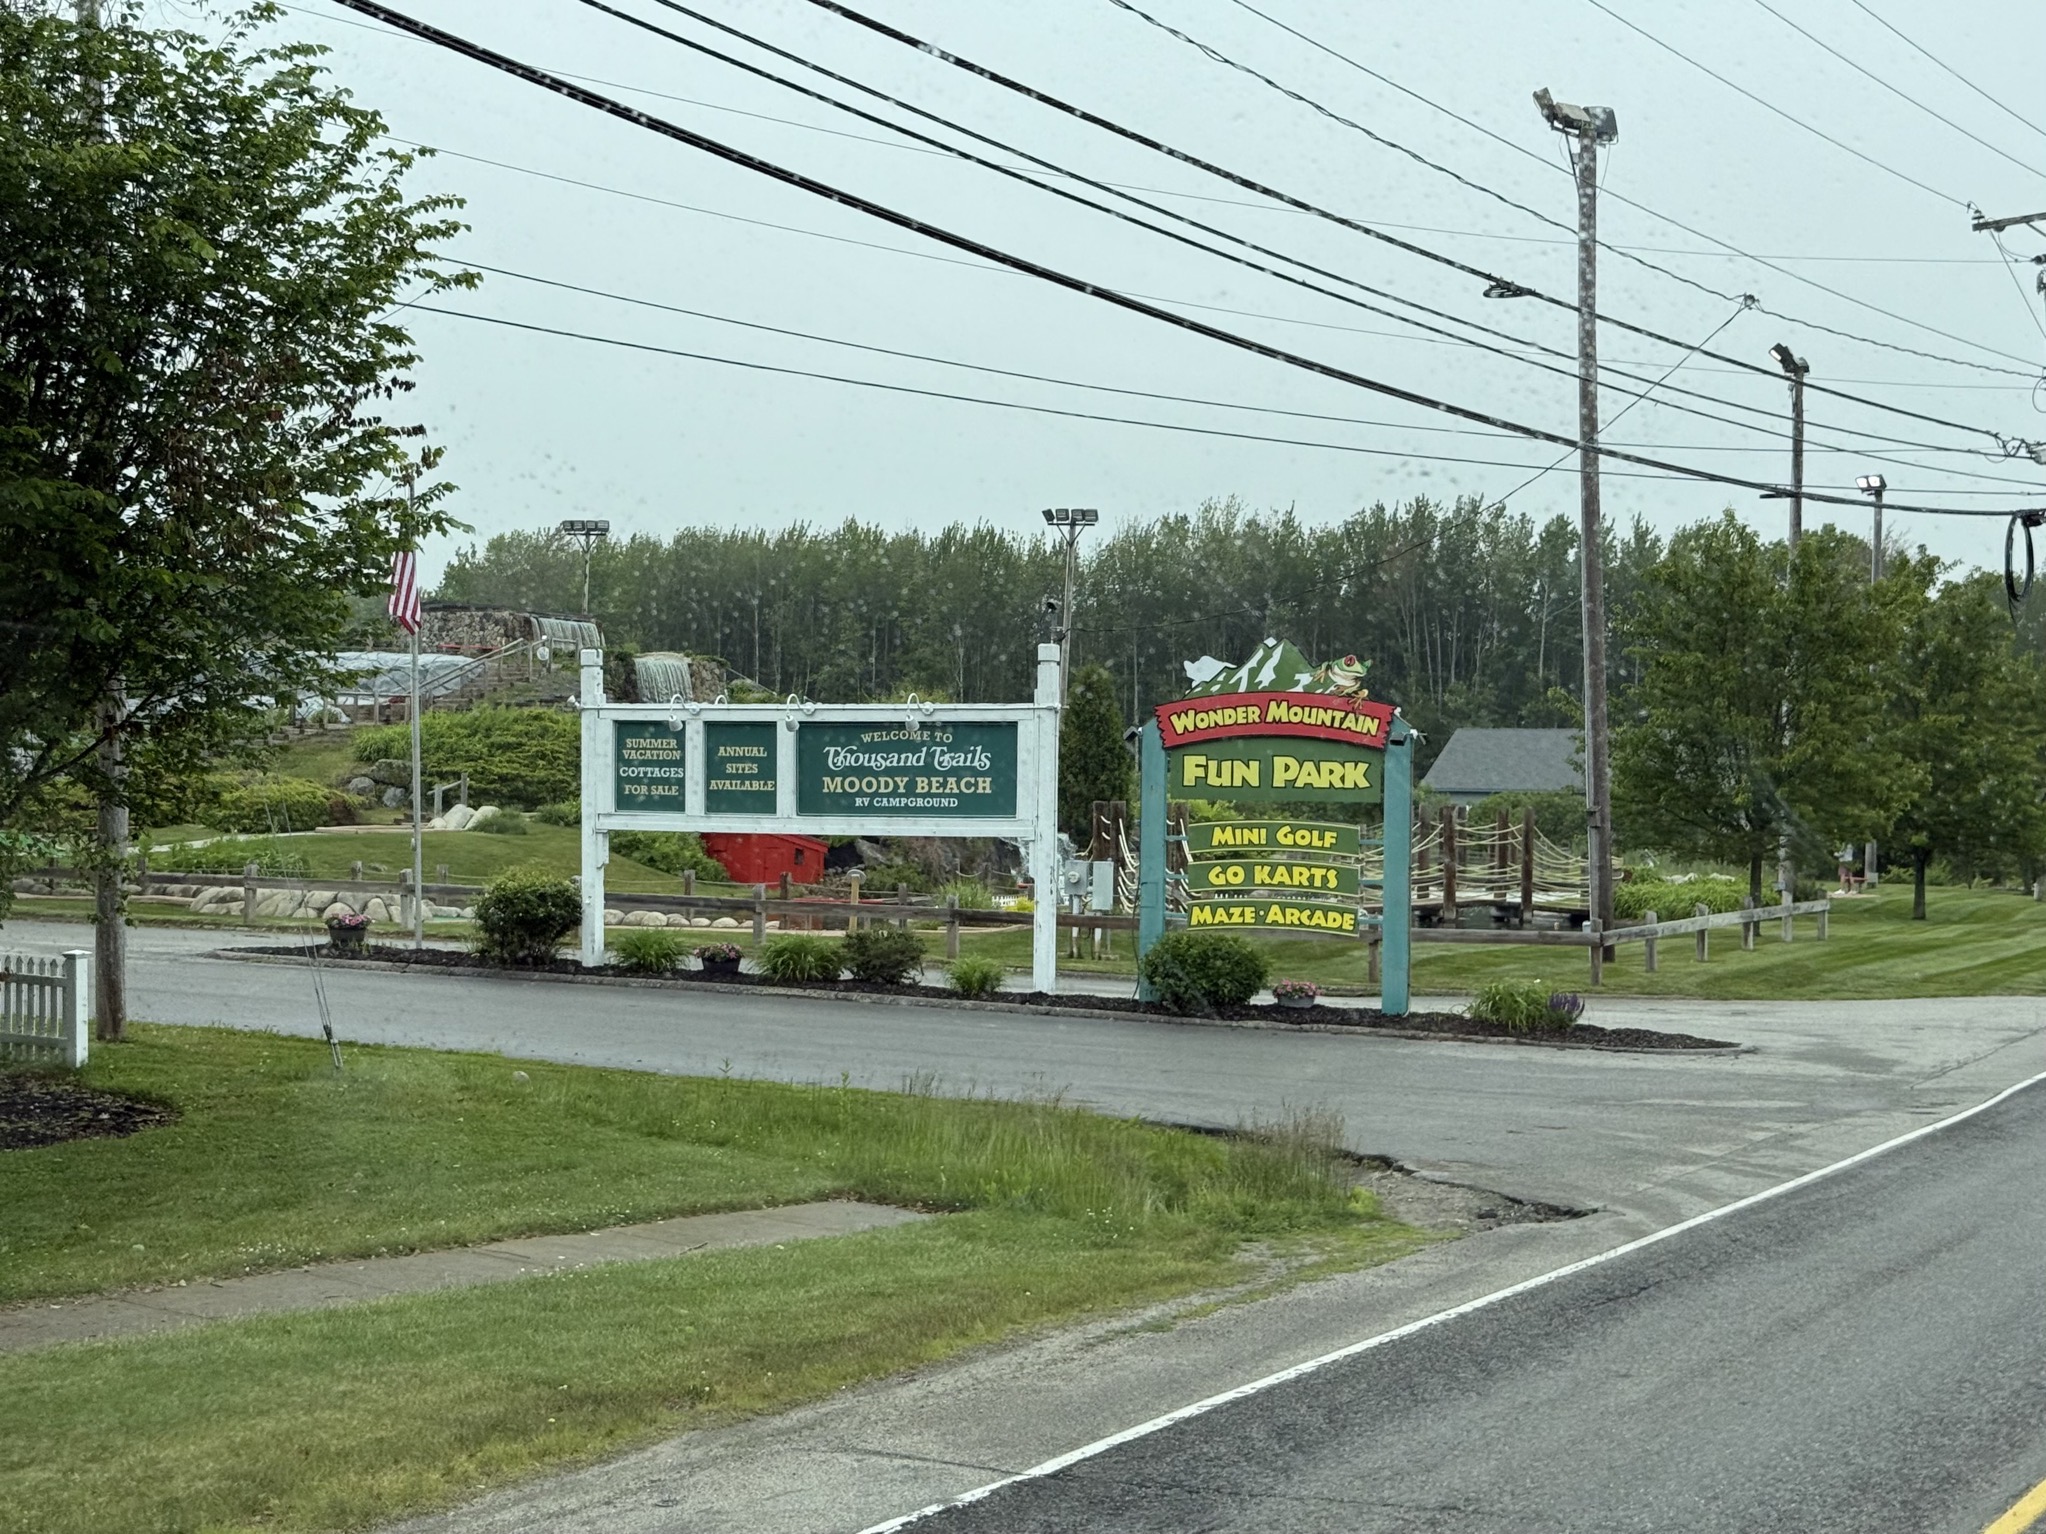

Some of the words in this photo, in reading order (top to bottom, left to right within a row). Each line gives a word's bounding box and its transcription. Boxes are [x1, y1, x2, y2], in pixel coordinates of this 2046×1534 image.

[1169, 705, 1261, 735] WONDER
[1265, 700, 1380, 736] MOUNTAIN
[626, 738, 678, 749] SUMMER
[861, 730, 931, 744] WELCOME
[934, 731, 953, 743] TO
[622, 750, 681, 760] VACATION
[717, 746, 767, 757] ANNUAL
[823, 745, 926, 771] Thousand
[929, 745, 991, 771] Trails
[619, 767, 684, 778] COTTAGES
[725, 763, 758, 774] SITES
[1183, 755, 1260, 787] FUN
[1272, 755, 1371, 789] PARK
[624, 785, 648, 795] FOR
[651, 785, 679, 796] SALE
[709, 779, 776, 791] AVAILABLE
[822, 776, 910, 794] MOODY
[916, 776, 992, 794] BEACH
[855, 797, 871, 808] RV
[873, 797, 958, 808] CAMPGROUND
[1211, 825, 1267, 846] MINI
[1275, 825, 1338, 848] GOLF
[1208, 865, 1245, 885] GO
[1254, 865, 1338, 888] KARTS
[1190, 905, 1256, 926] MAZE
[1265, 904, 1355, 930] ARCADE
